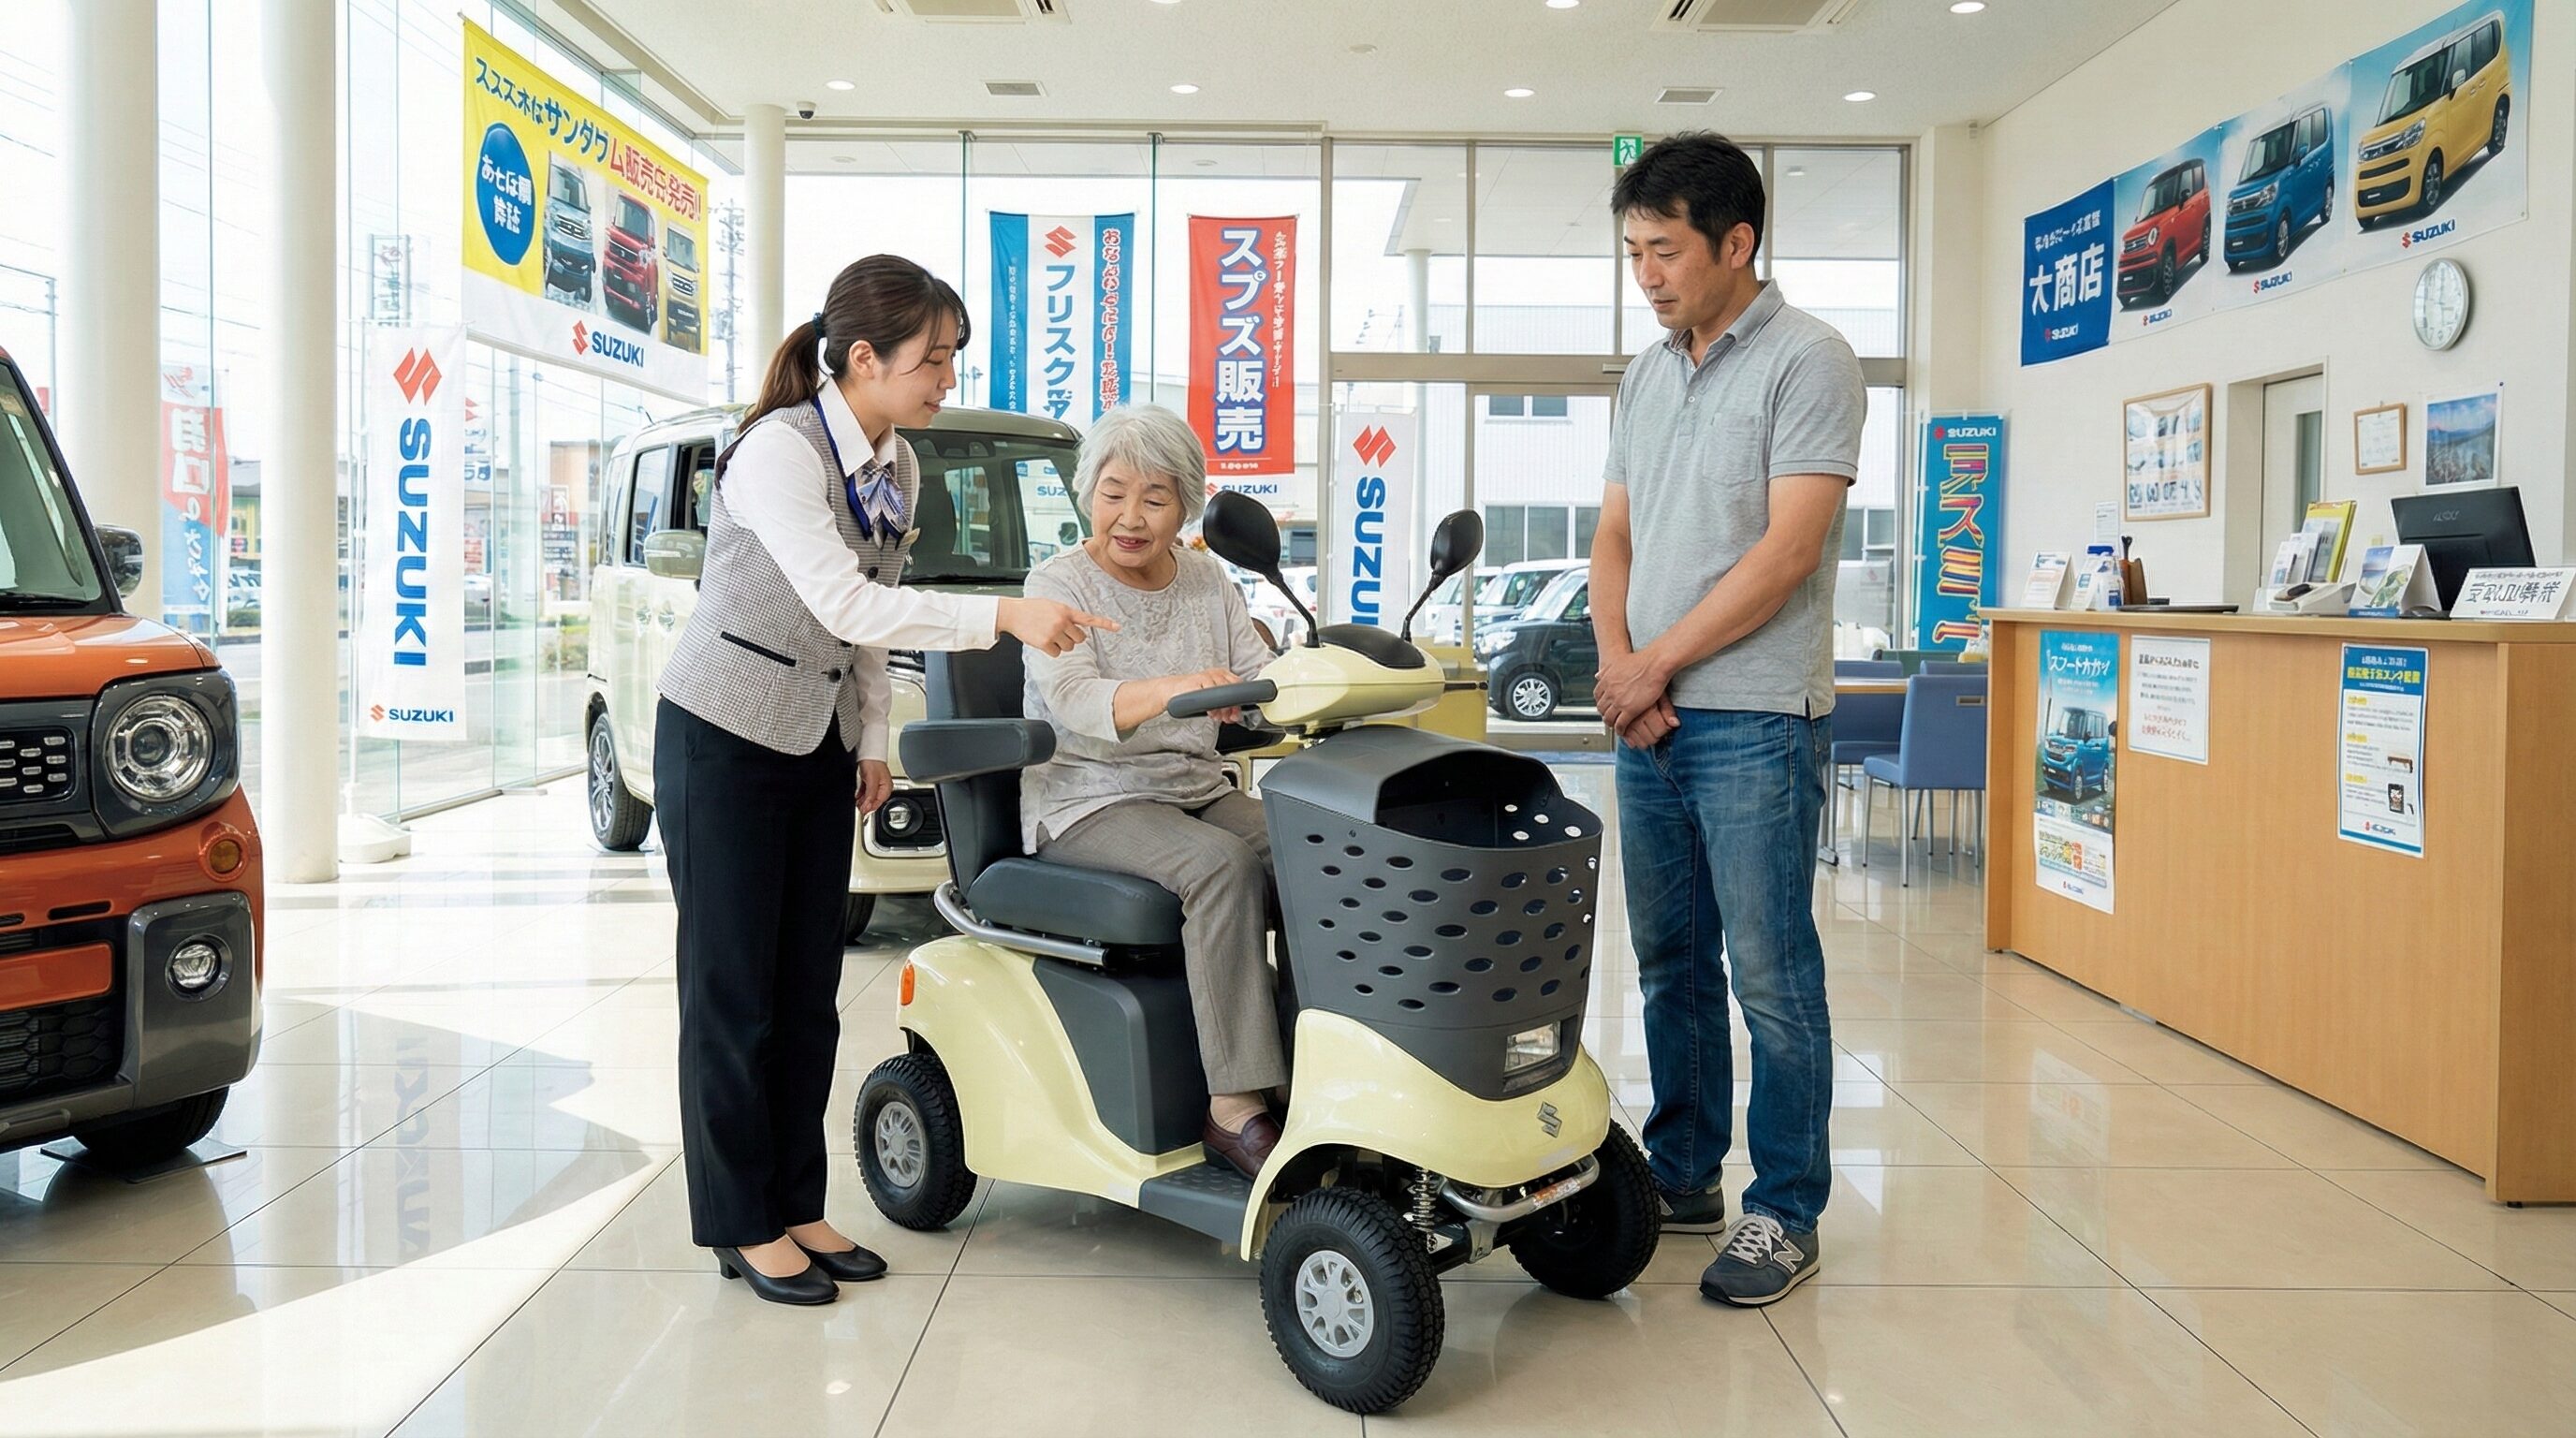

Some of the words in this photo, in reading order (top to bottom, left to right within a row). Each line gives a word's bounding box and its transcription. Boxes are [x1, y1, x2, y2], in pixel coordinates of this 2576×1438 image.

[2412, 219, 2455, 243] SUZUKI
[2029, 242, 2105, 315] 大商店
[592, 330, 645, 368] SUZUKI
[1216, 228, 1266, 452] スプズ販売
[1947, 427, 1997, 438] SUZUKI
[394, 418, 432, 667] SUZUKI
[1351, 476, 1385, 625] SUZU
[388, 709, 454, 723] SUZUKI
[1773, 1239, 1805, 1274] N
